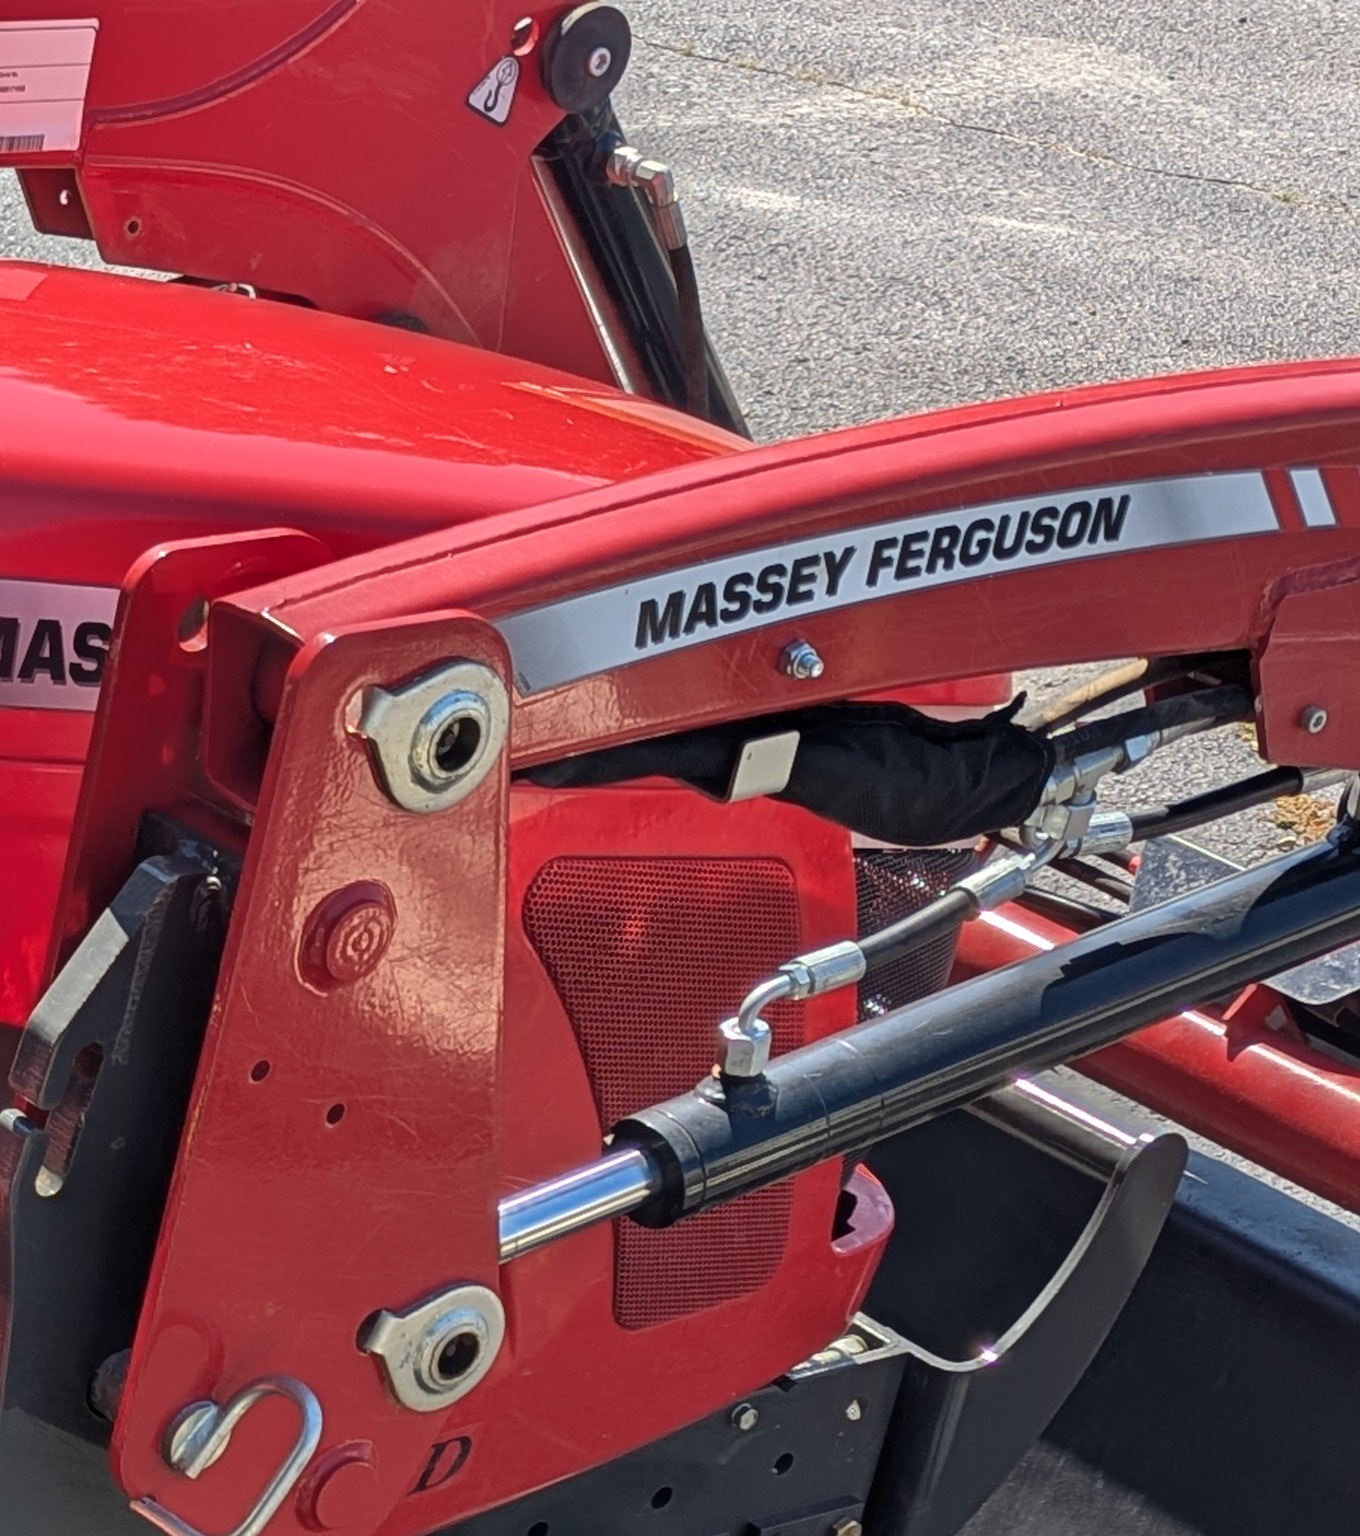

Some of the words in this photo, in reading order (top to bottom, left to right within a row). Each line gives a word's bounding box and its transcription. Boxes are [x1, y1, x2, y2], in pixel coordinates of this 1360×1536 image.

[634, 545, 856, 650] MASSEY
[864, 494, 1132, 589] FERGUSON
[407, 1435, 473, 1497] D
